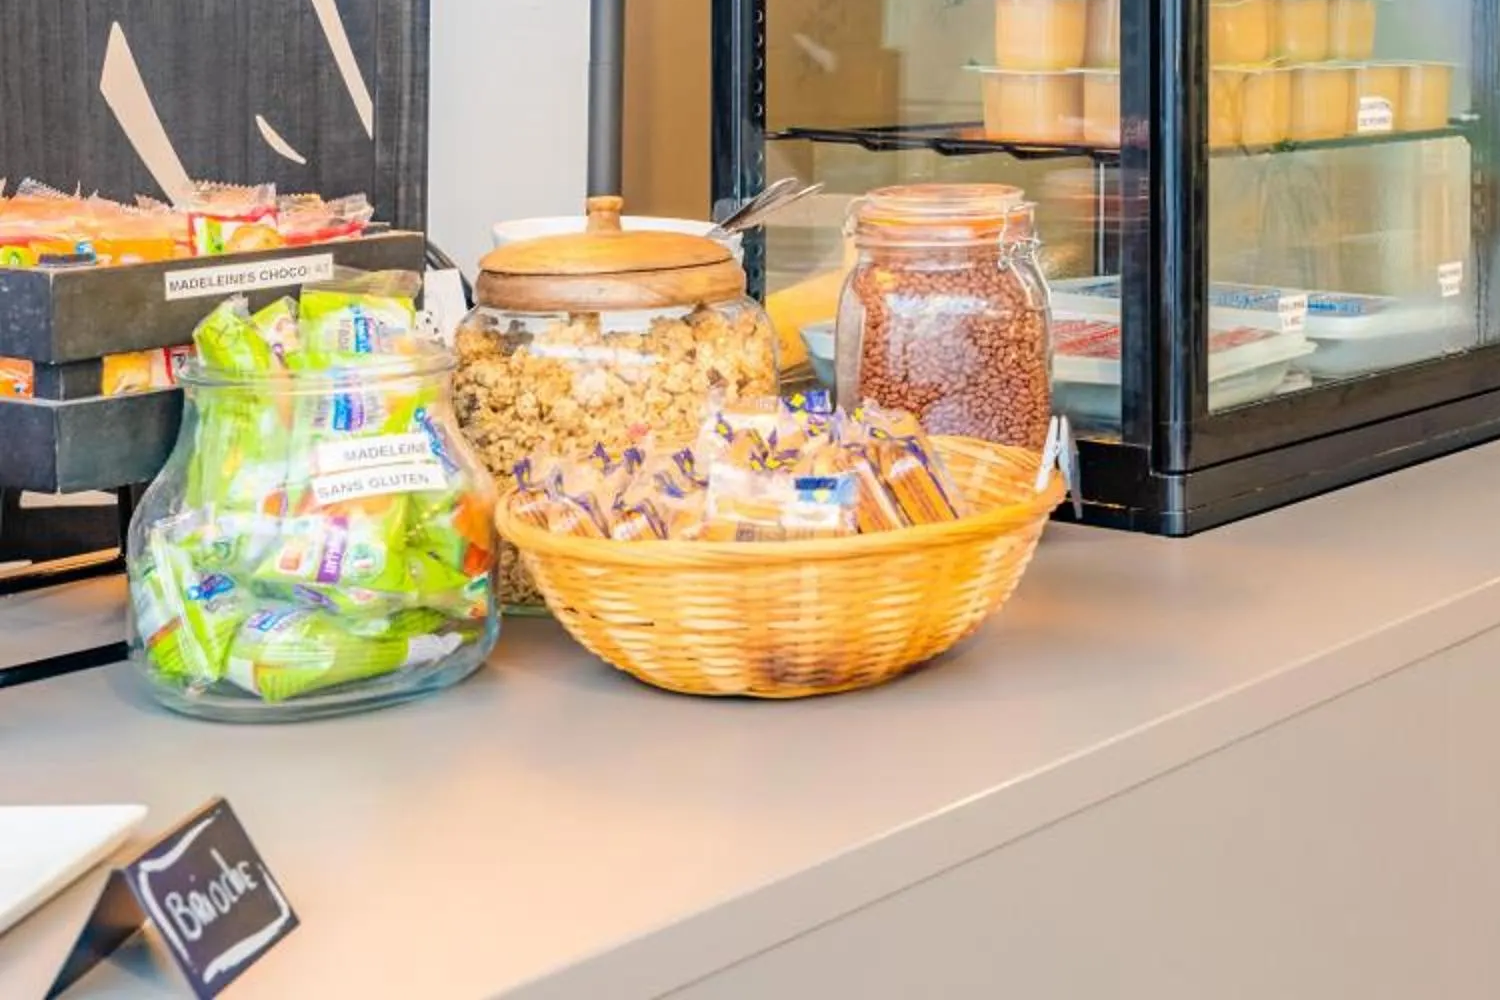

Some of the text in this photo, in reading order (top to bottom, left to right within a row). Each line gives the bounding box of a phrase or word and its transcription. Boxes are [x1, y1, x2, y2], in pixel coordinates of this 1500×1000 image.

[169, 271, 257, 293] MADELEINES
[317, 472, 430, 499] SANS GLUTEN
